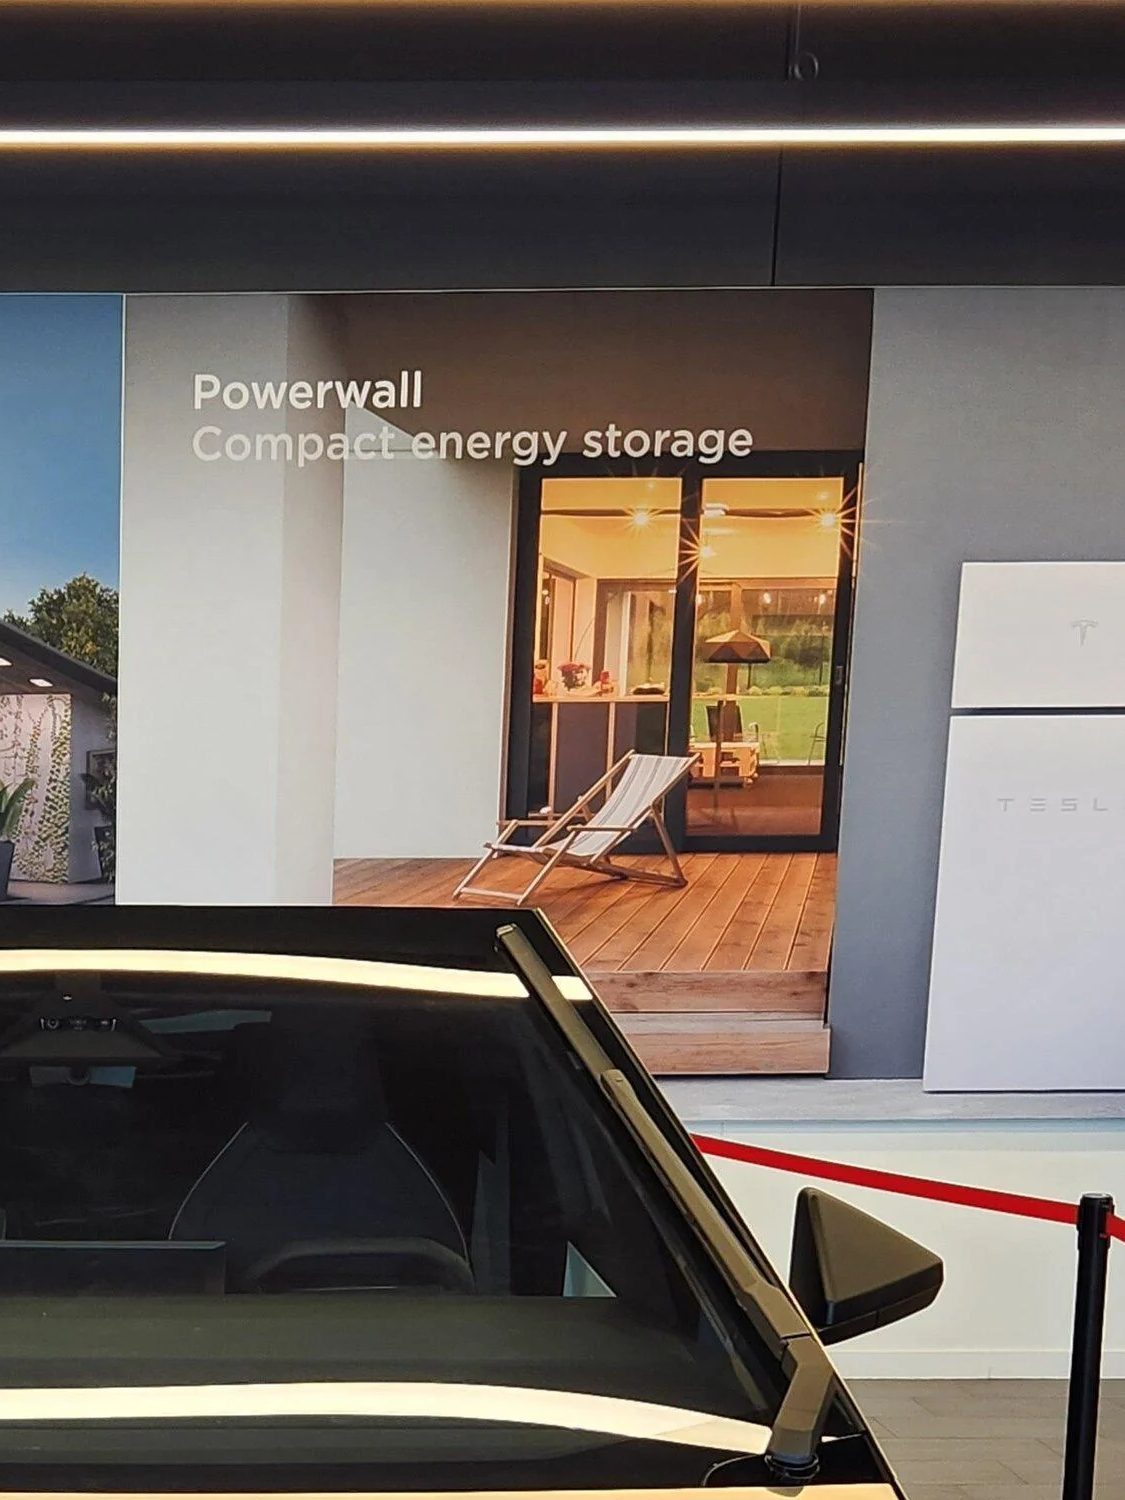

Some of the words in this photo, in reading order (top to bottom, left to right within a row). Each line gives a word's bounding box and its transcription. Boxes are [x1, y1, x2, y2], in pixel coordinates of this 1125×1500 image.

[193, 371, 422, 409] Powerwall
[192, 425, 395, 467] Compact
[411, 429, 568, 466] energy
[582, 423, 754, 464] storage
[997, 797, 1125, 812] TESL
